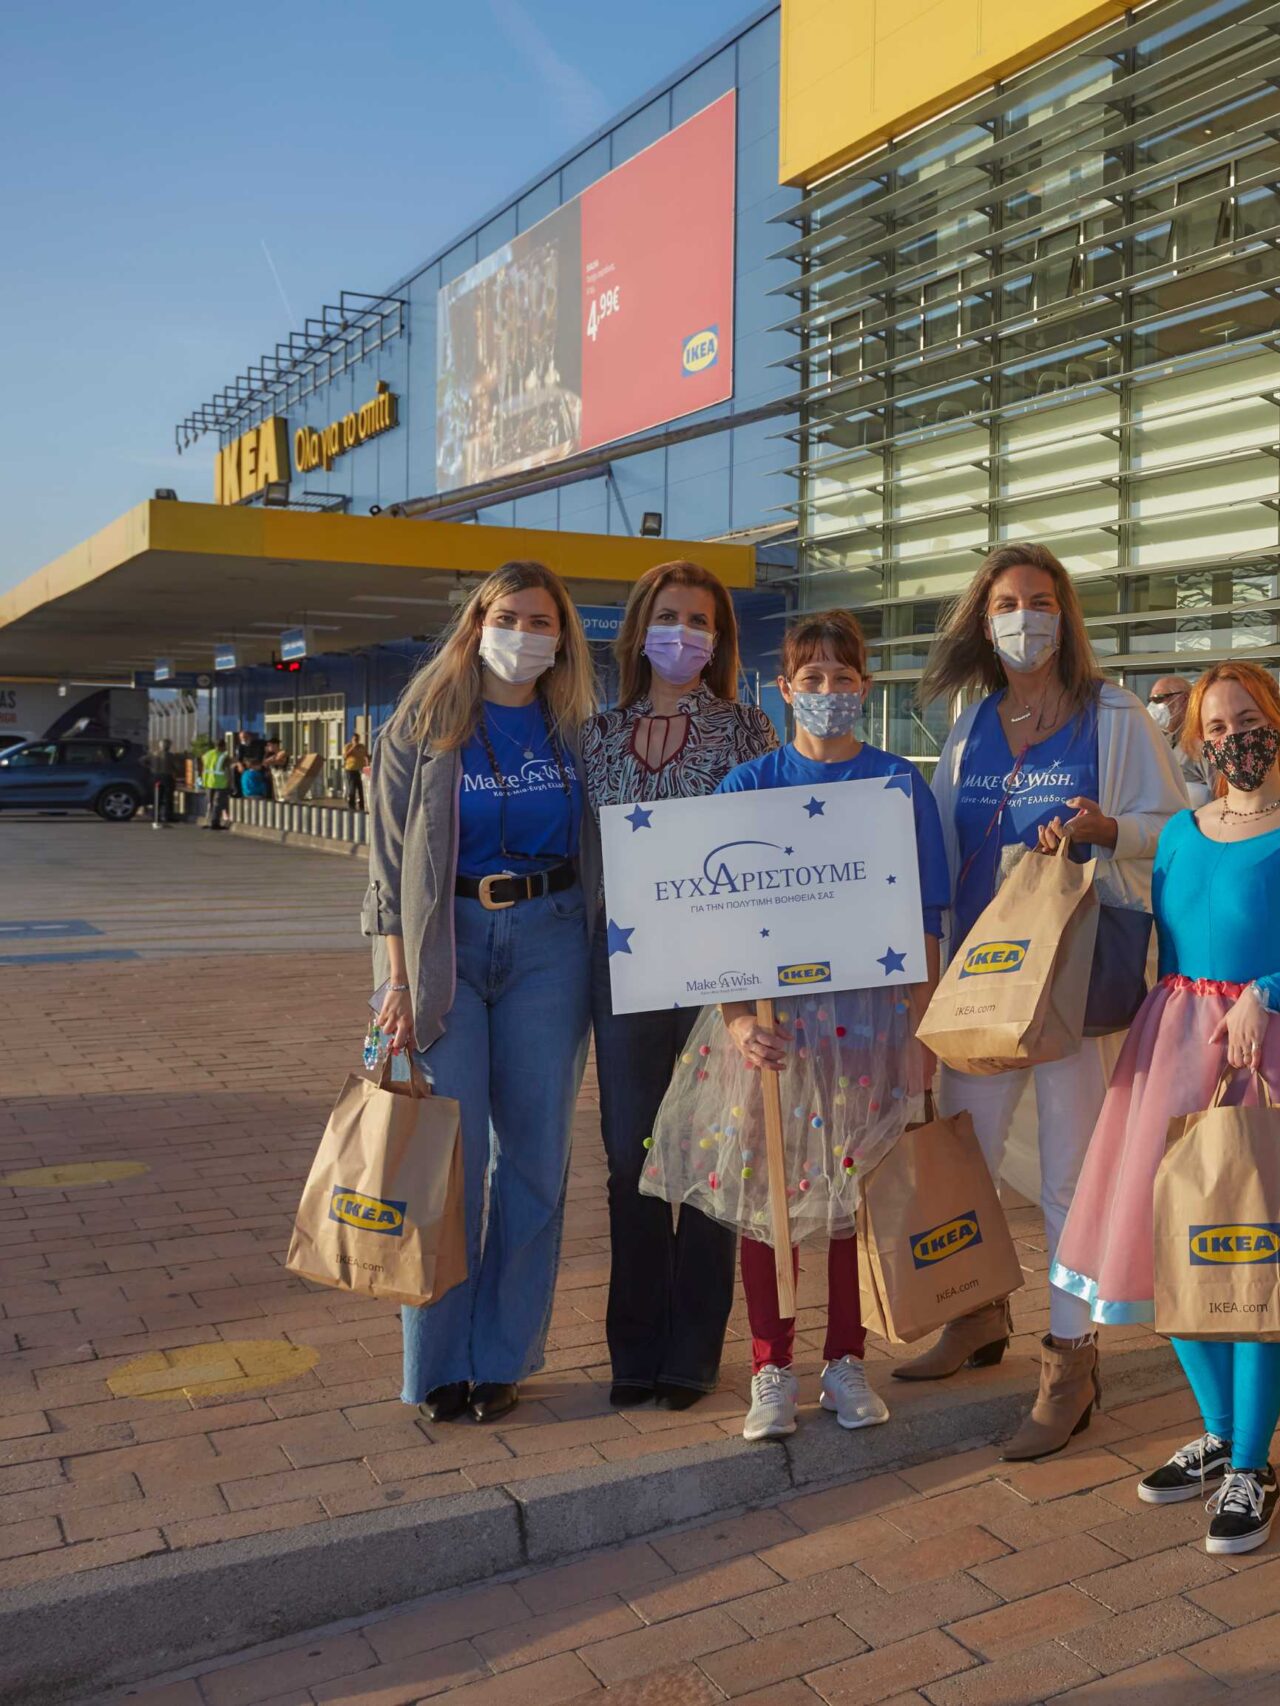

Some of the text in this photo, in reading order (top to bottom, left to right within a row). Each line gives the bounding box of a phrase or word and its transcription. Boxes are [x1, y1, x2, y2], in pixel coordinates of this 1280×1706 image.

[587, 286, 620, 342] 4,99€
[685, 337, 716, 365] IKEA
[321, 421, 343, 471] για
[343, 411, 358, 448] το
[214, 416, 290, 506] IKEA
[583, 618, 624, 630] ρτωσ
[655, 861, 867, 902] ΕΥΧΑΡΙΣΤΟΥΜΕ
[691, 891, 834, 913] ΓΙΑ ΤΗΝ ΠΟΛΥΤΙΜΗ ΒΟΗΘΕΙΑ ΣΑΣ
[967, 949, 1020, 968] IKEA
[783, 967, 826, 980] IKEA
[955, 1004, 996, 1017] IKEA.com
[335, 1197, 397, 1225] IKEA
[920, 1223, 974, 1256] IKEA
[1198, 1234, 1276, 1253] IKEA
[935, 1279, 979, 1304] IKEA.com
[1209, 1302, 1269, 1314] IKEA.com
